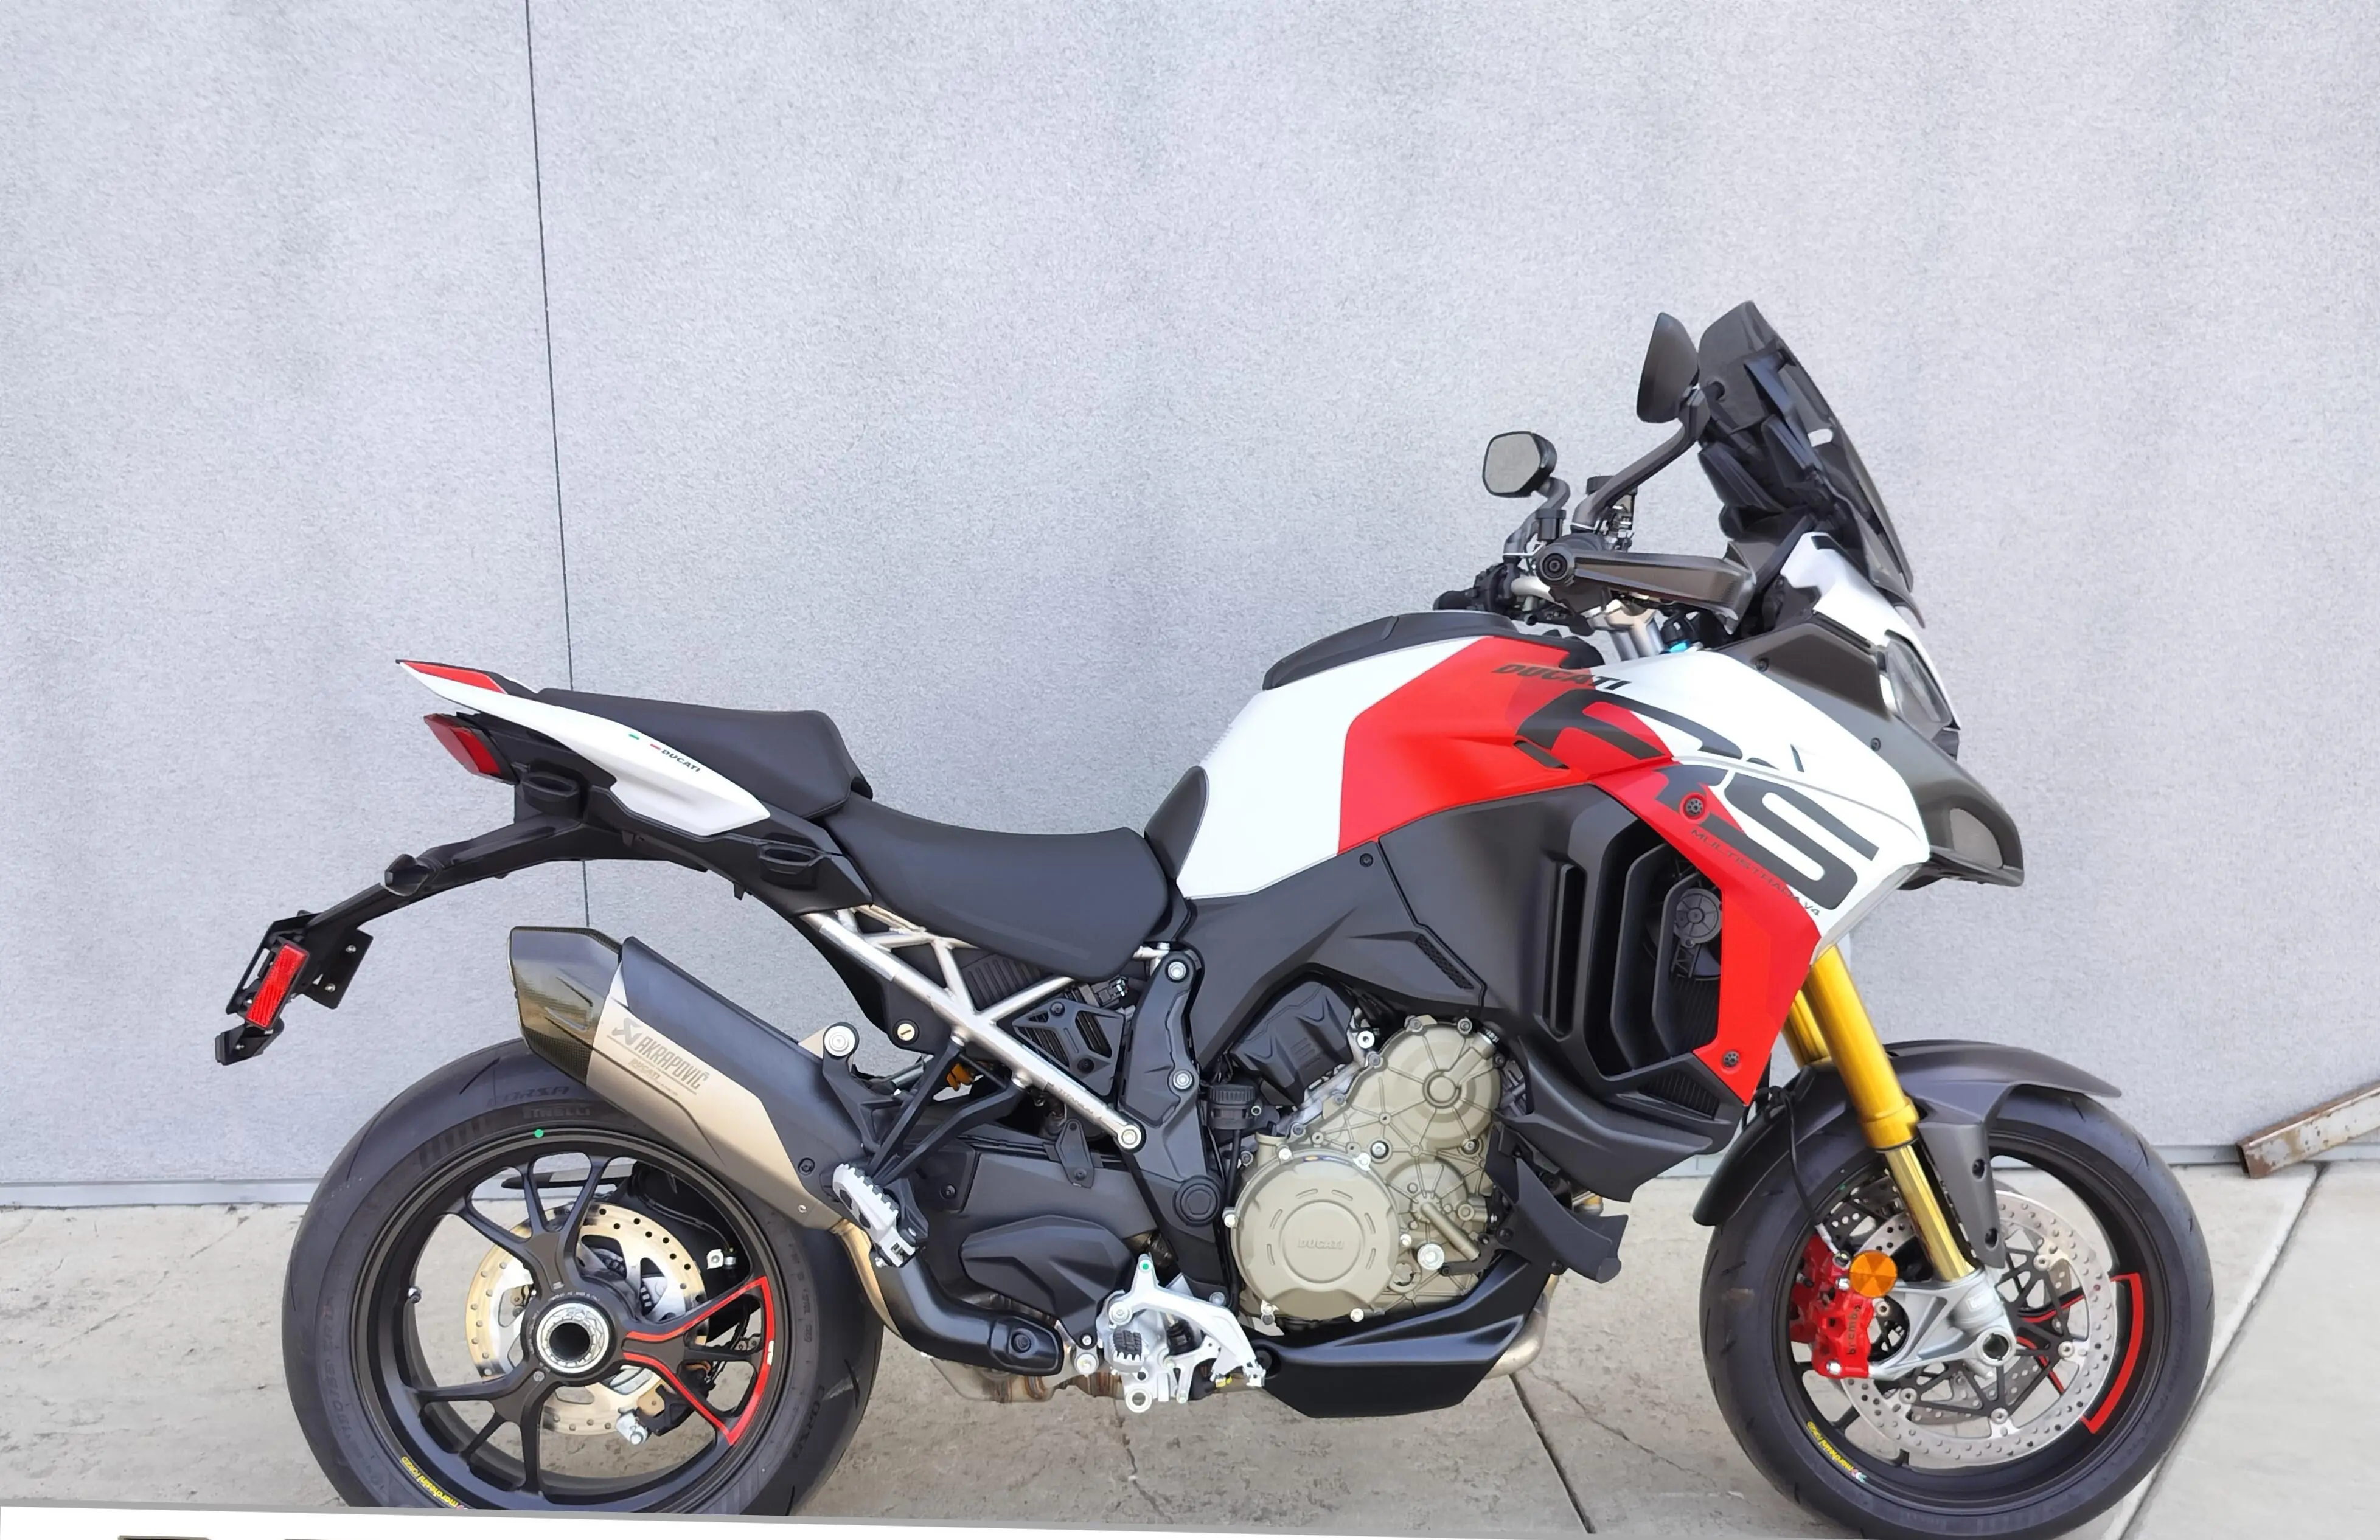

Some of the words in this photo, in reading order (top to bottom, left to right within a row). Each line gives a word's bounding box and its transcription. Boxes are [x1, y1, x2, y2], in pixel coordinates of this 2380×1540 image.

[1492, 664, 1632, 691] DUCATI
[661, 749, 701, 772] DUCATI
[1691, 829, 1800, 903] MULTISTRADA
[1804, 901, 1820, 917] V4
[1297, 1238, 1344, 1250] DUCATI
[1846, 1304, 1862, 1355] brembo
[416, 1475, 459, 1508] marchesini
